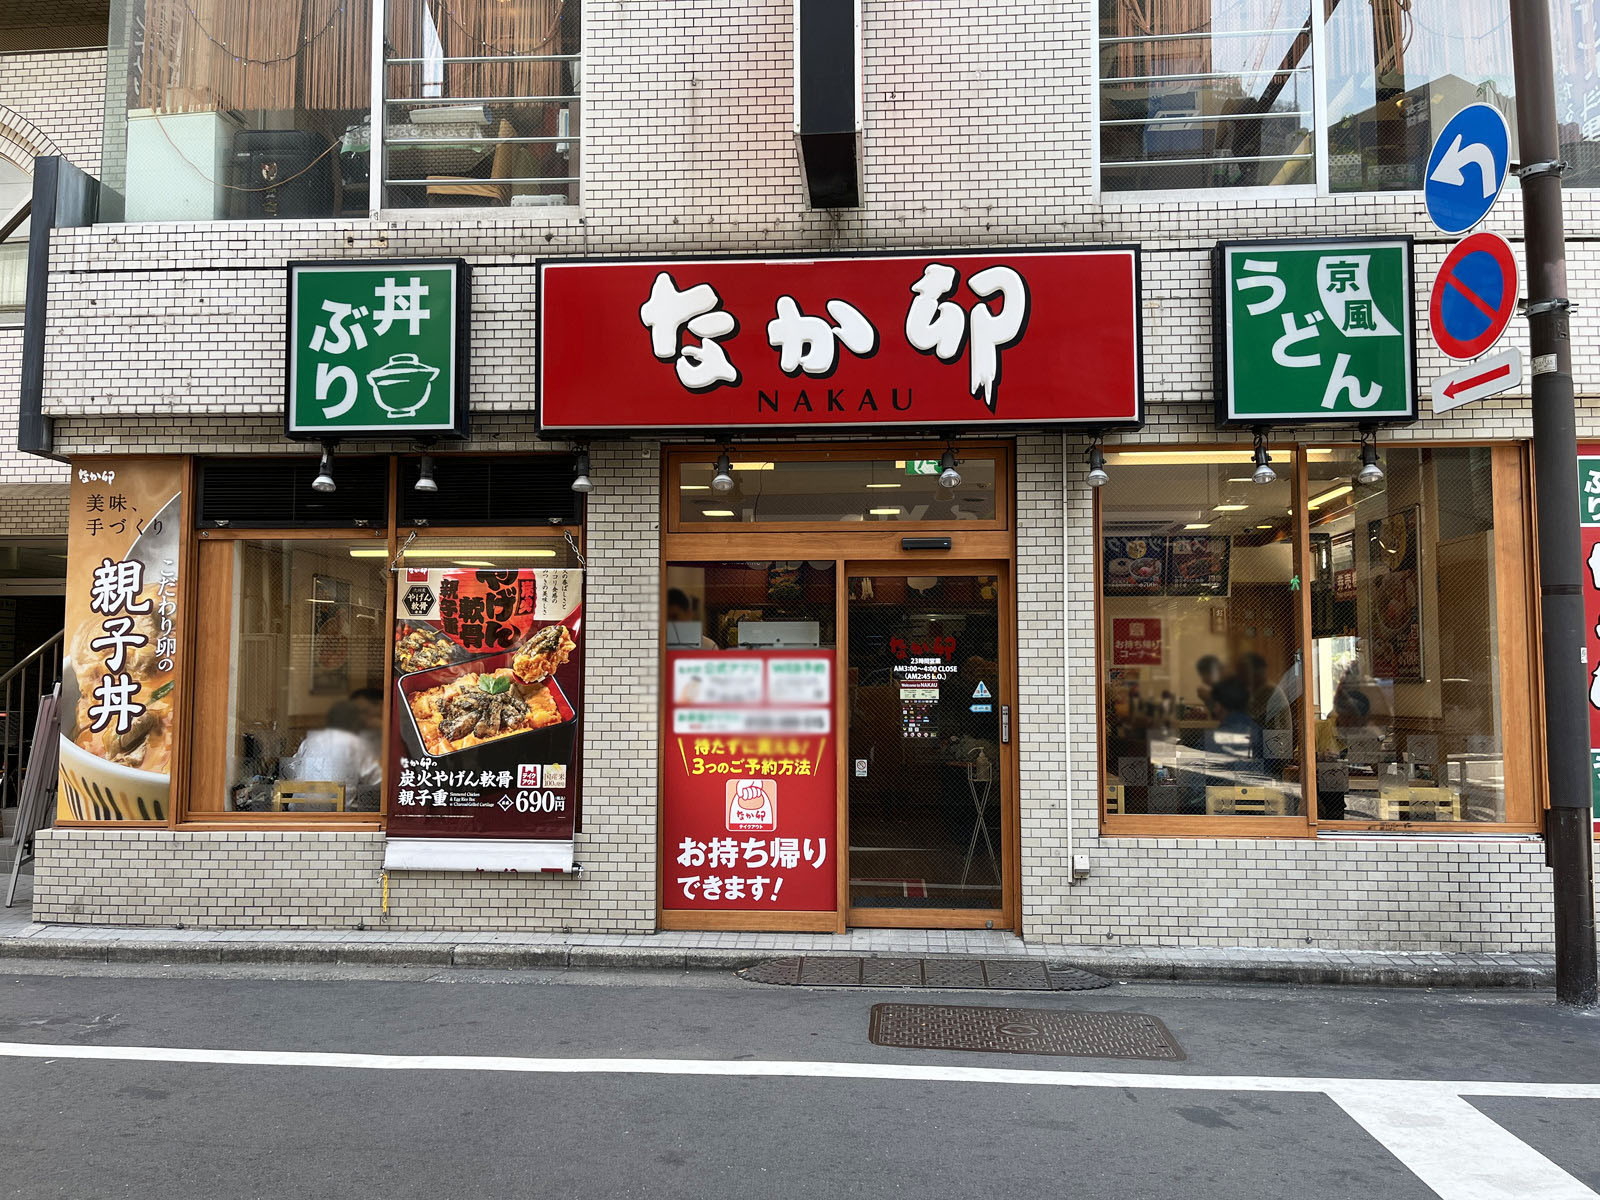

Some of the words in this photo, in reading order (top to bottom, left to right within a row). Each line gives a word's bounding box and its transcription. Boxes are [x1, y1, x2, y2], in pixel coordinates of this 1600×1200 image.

[1326, 261, 1377, 331] 京風
[640, 262, 1029, 411] なか卯
[1235, 258, 1382, 409] うどん
[757, 388, 913, 412] NAKAU
[79, 469, 115, 485] なか卯
[86, 518, 163, 536] 手づくり
[88, 557, 153, 735] 親子丼
[692, 757, 811, 775] 3つのご予約方法
[399, 769, 514, 788] 炭火やげん軟骨
[398, 789, 448, 807] 親子重
[736, 810, 766, 822] なか卯
[676, 837, 827, 869] お持ち帰り
